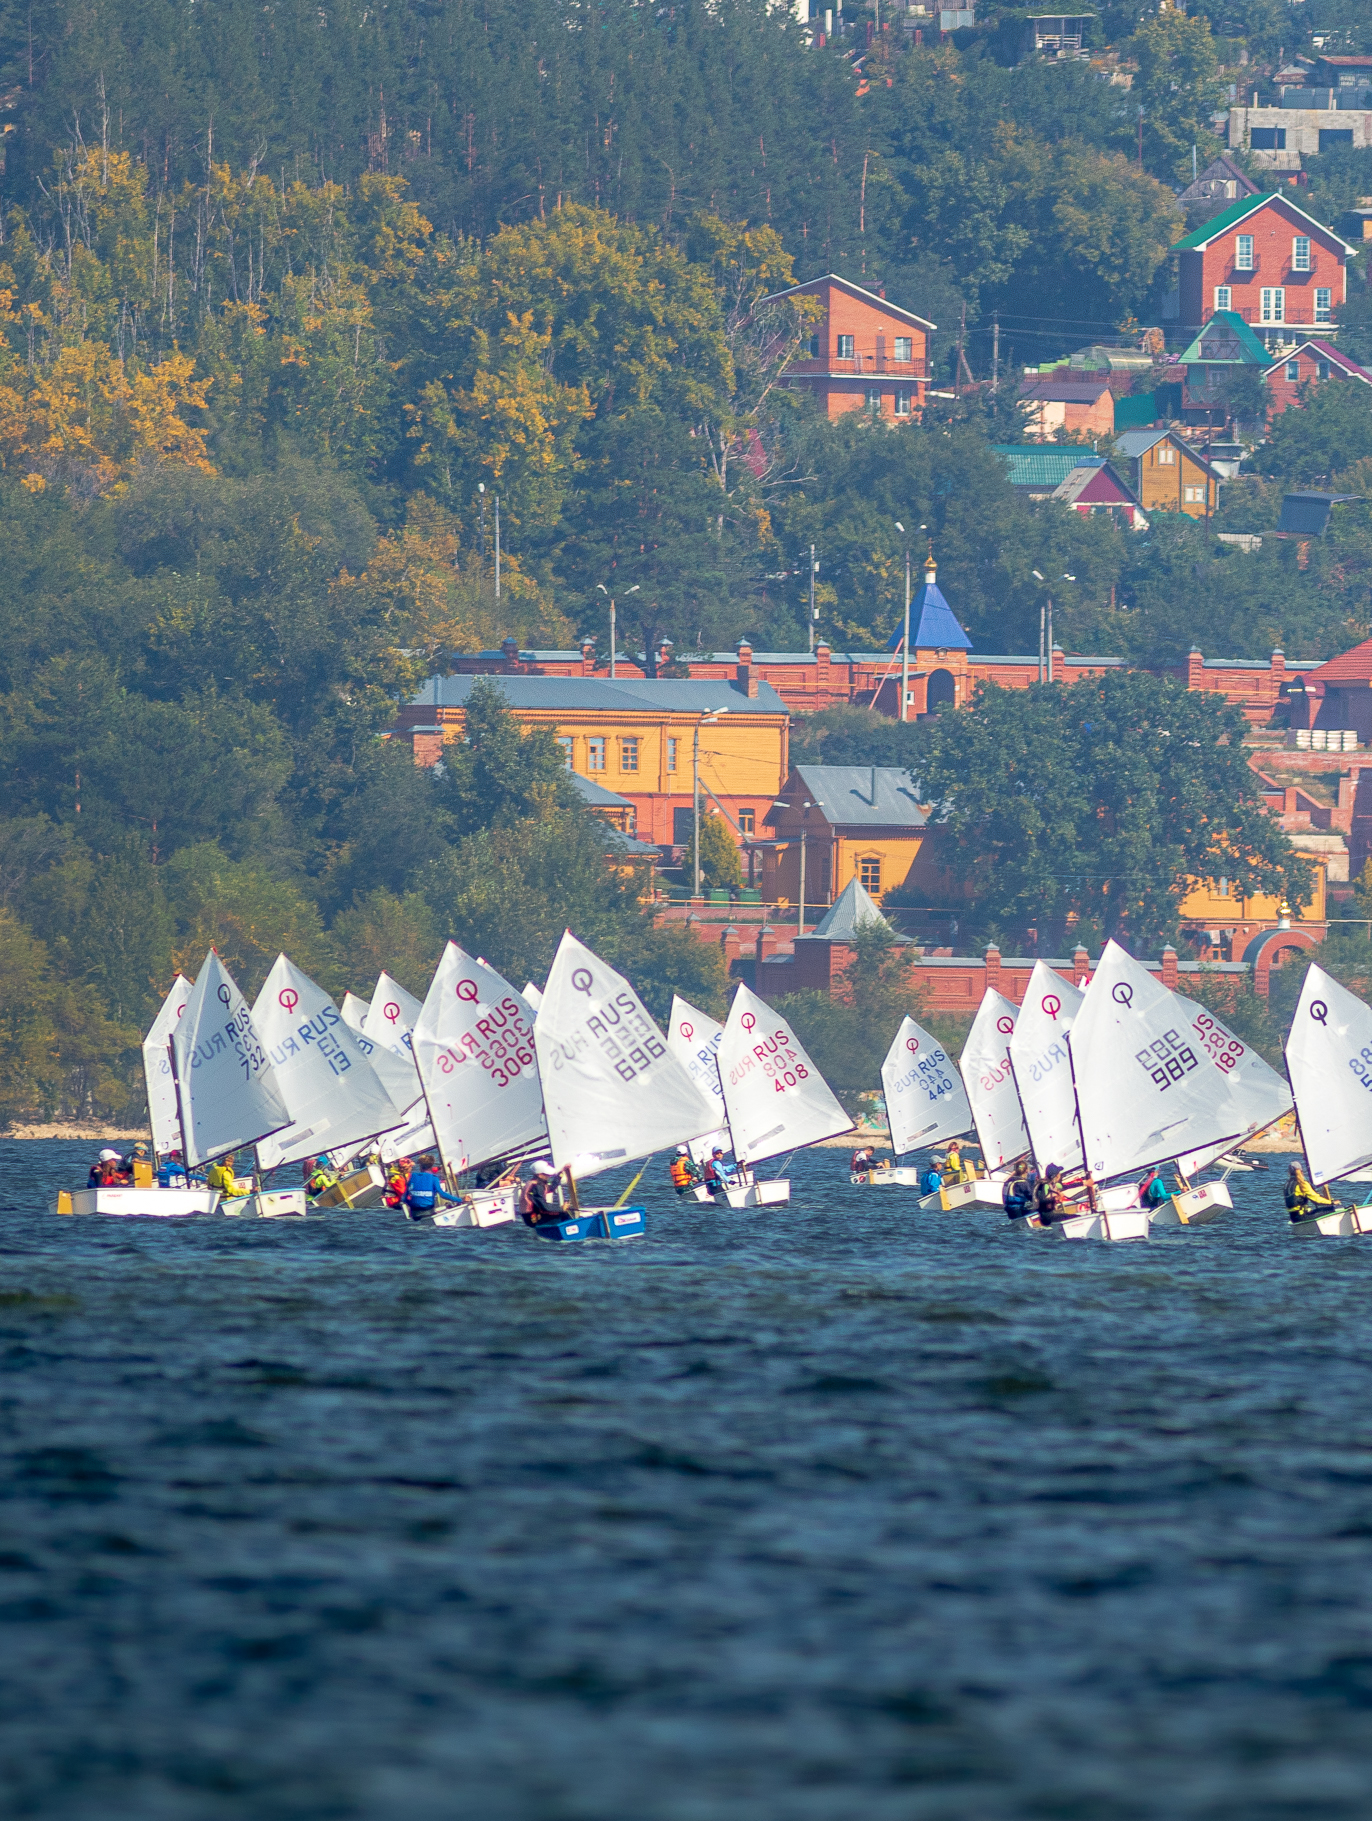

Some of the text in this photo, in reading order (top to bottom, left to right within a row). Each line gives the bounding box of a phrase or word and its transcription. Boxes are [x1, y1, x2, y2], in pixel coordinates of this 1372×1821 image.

[224, 1007, 250, 1043] RUS
[297, 1005, 340, 1045] RUS
[475, 997, 519, 1041] RUS
[586, 992, 636, 1039] RUS
[241, 1045, 265, 1081] 732
[613, 1035, 666, 1082] 696
[753, 1030, 789, 1062] RUS
[917, 1049, 945, 1075] RUS
[1214, 1040, 1245, 1074] 189
[774, 1063, 809, 1093] 408
[1151, 1046, 1199, 1092] 989
[928, 1078, 953, 1102] 440
